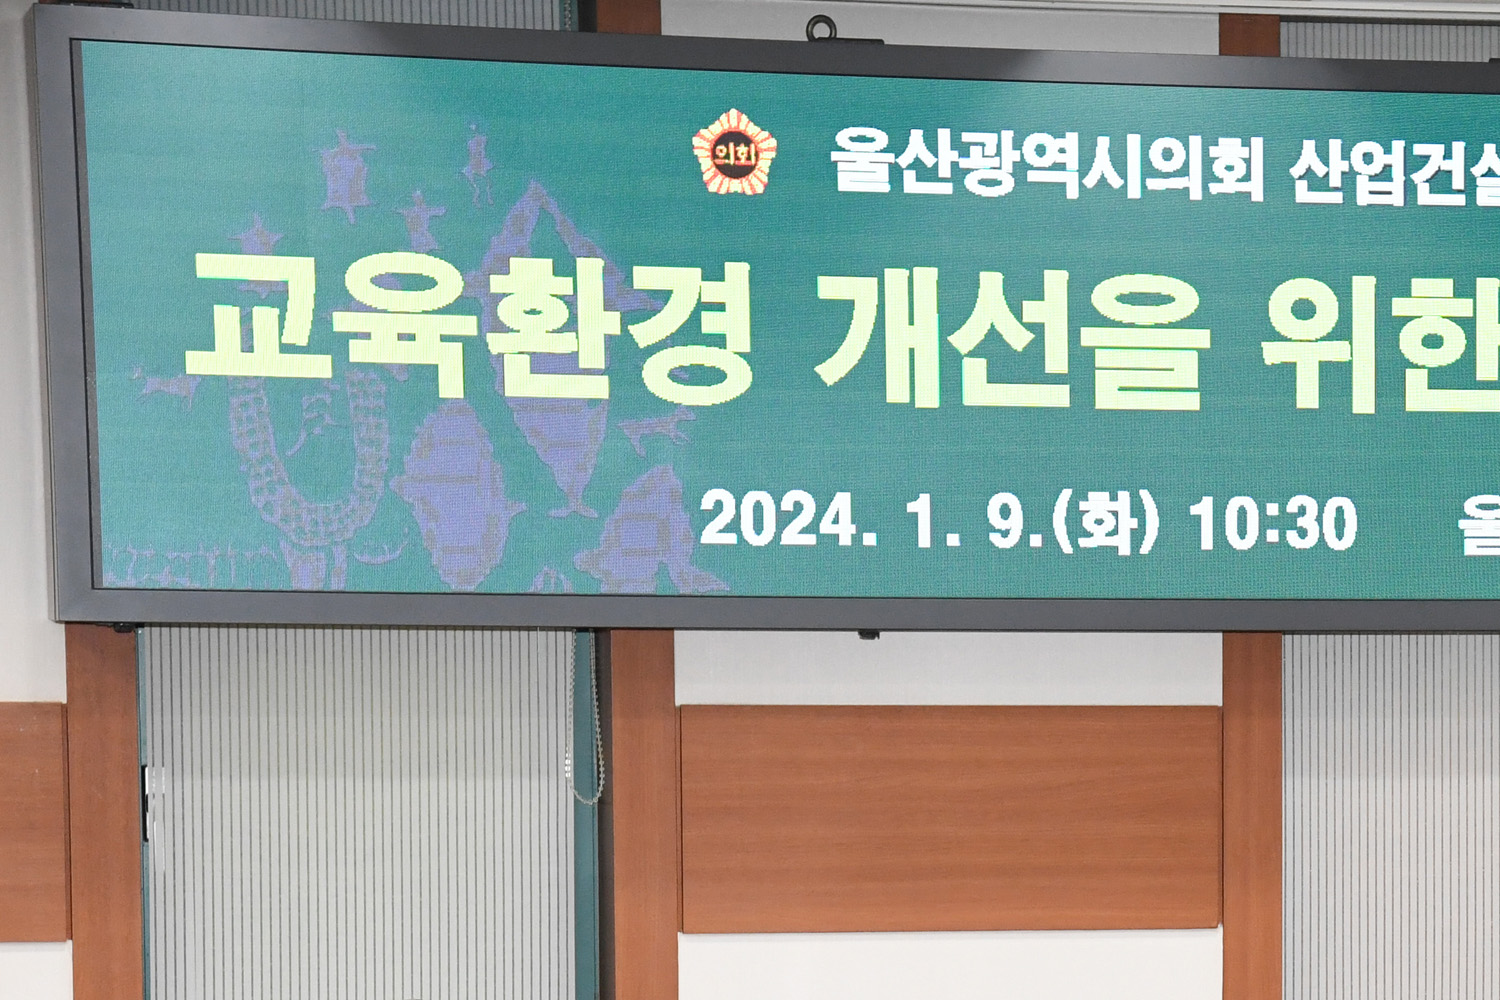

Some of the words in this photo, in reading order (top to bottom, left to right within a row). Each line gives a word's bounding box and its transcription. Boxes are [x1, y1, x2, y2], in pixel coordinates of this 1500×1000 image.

[714, 142, 756, 166] 의회
[831, 127, 1264, 203] 울산광역시의회
[186, 251, 753, 406] 교육환경
[814, 267, 1211, 411] 개선을
[700, 489, 877, 547] 2024.
[907, 494, 961, 548] 1.
[988, 489, 1160, 556] 9.(화)
[1190, 495, 1358, 551] 10:30
